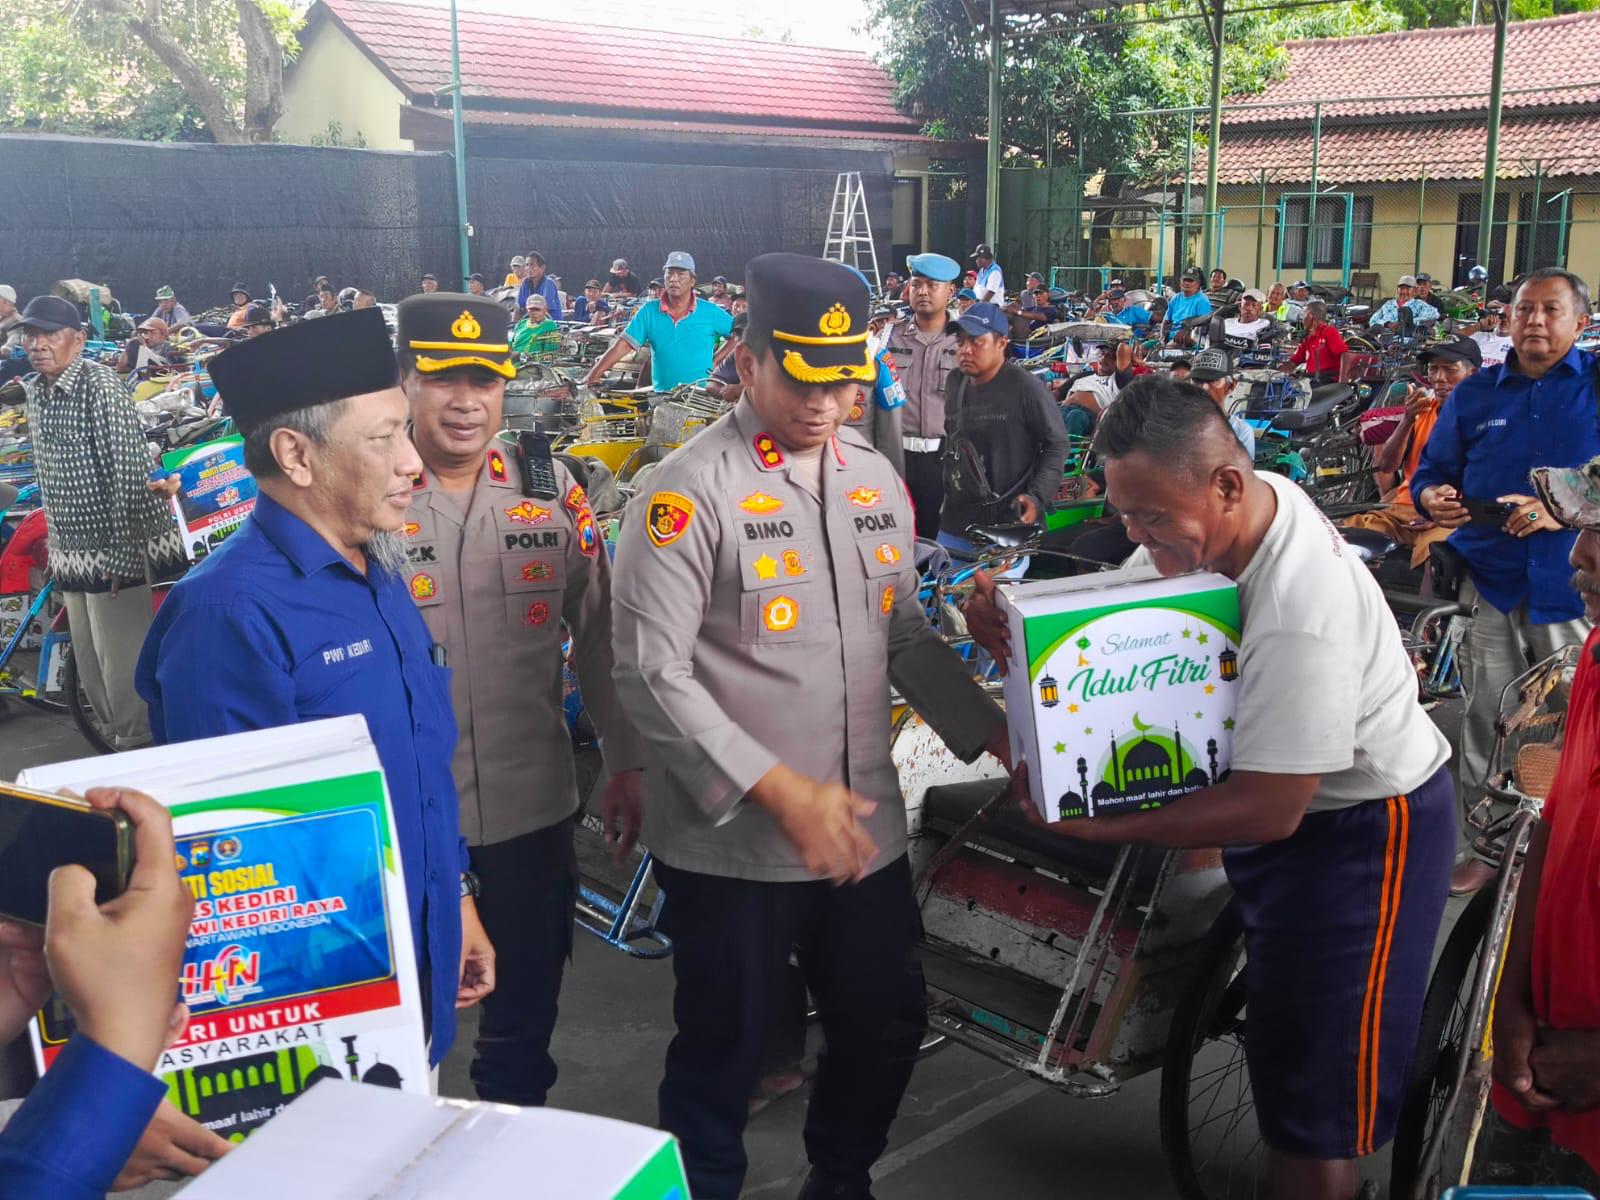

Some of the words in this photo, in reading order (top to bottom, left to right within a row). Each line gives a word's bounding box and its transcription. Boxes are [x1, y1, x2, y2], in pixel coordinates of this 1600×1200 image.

[743, 520, 795, 541] BIMO
[853, 512, 897, 534] POLRI
[504, 531, 559, 551] POLRI
[322, 646, 346, 666] PWI
[1101, 631, 1173, 656] Selamat
[1067, 664, 1140, 703] Idul
[1140, 653, 1213, 692] Fitri
[1097, 796, 1125, 807] Mohon
[1126, 792, 1147, 803] maaf
[1147, 790, 1167, 800] lahir
[1167, 787, 1184, 797] dan
[208, 863, 279, 897] SOSIAL
[216, 886, 298, 915] KEDIRI
[221, 907, 290, 933] KEDIRI
[293, 897, 348, 919] RAYA
[229, 1001, 322, 1034] UNTUK
[159, 1022, 326, 1069] ASYARAKAT
[240, 1105, 273, 1122] lahir
